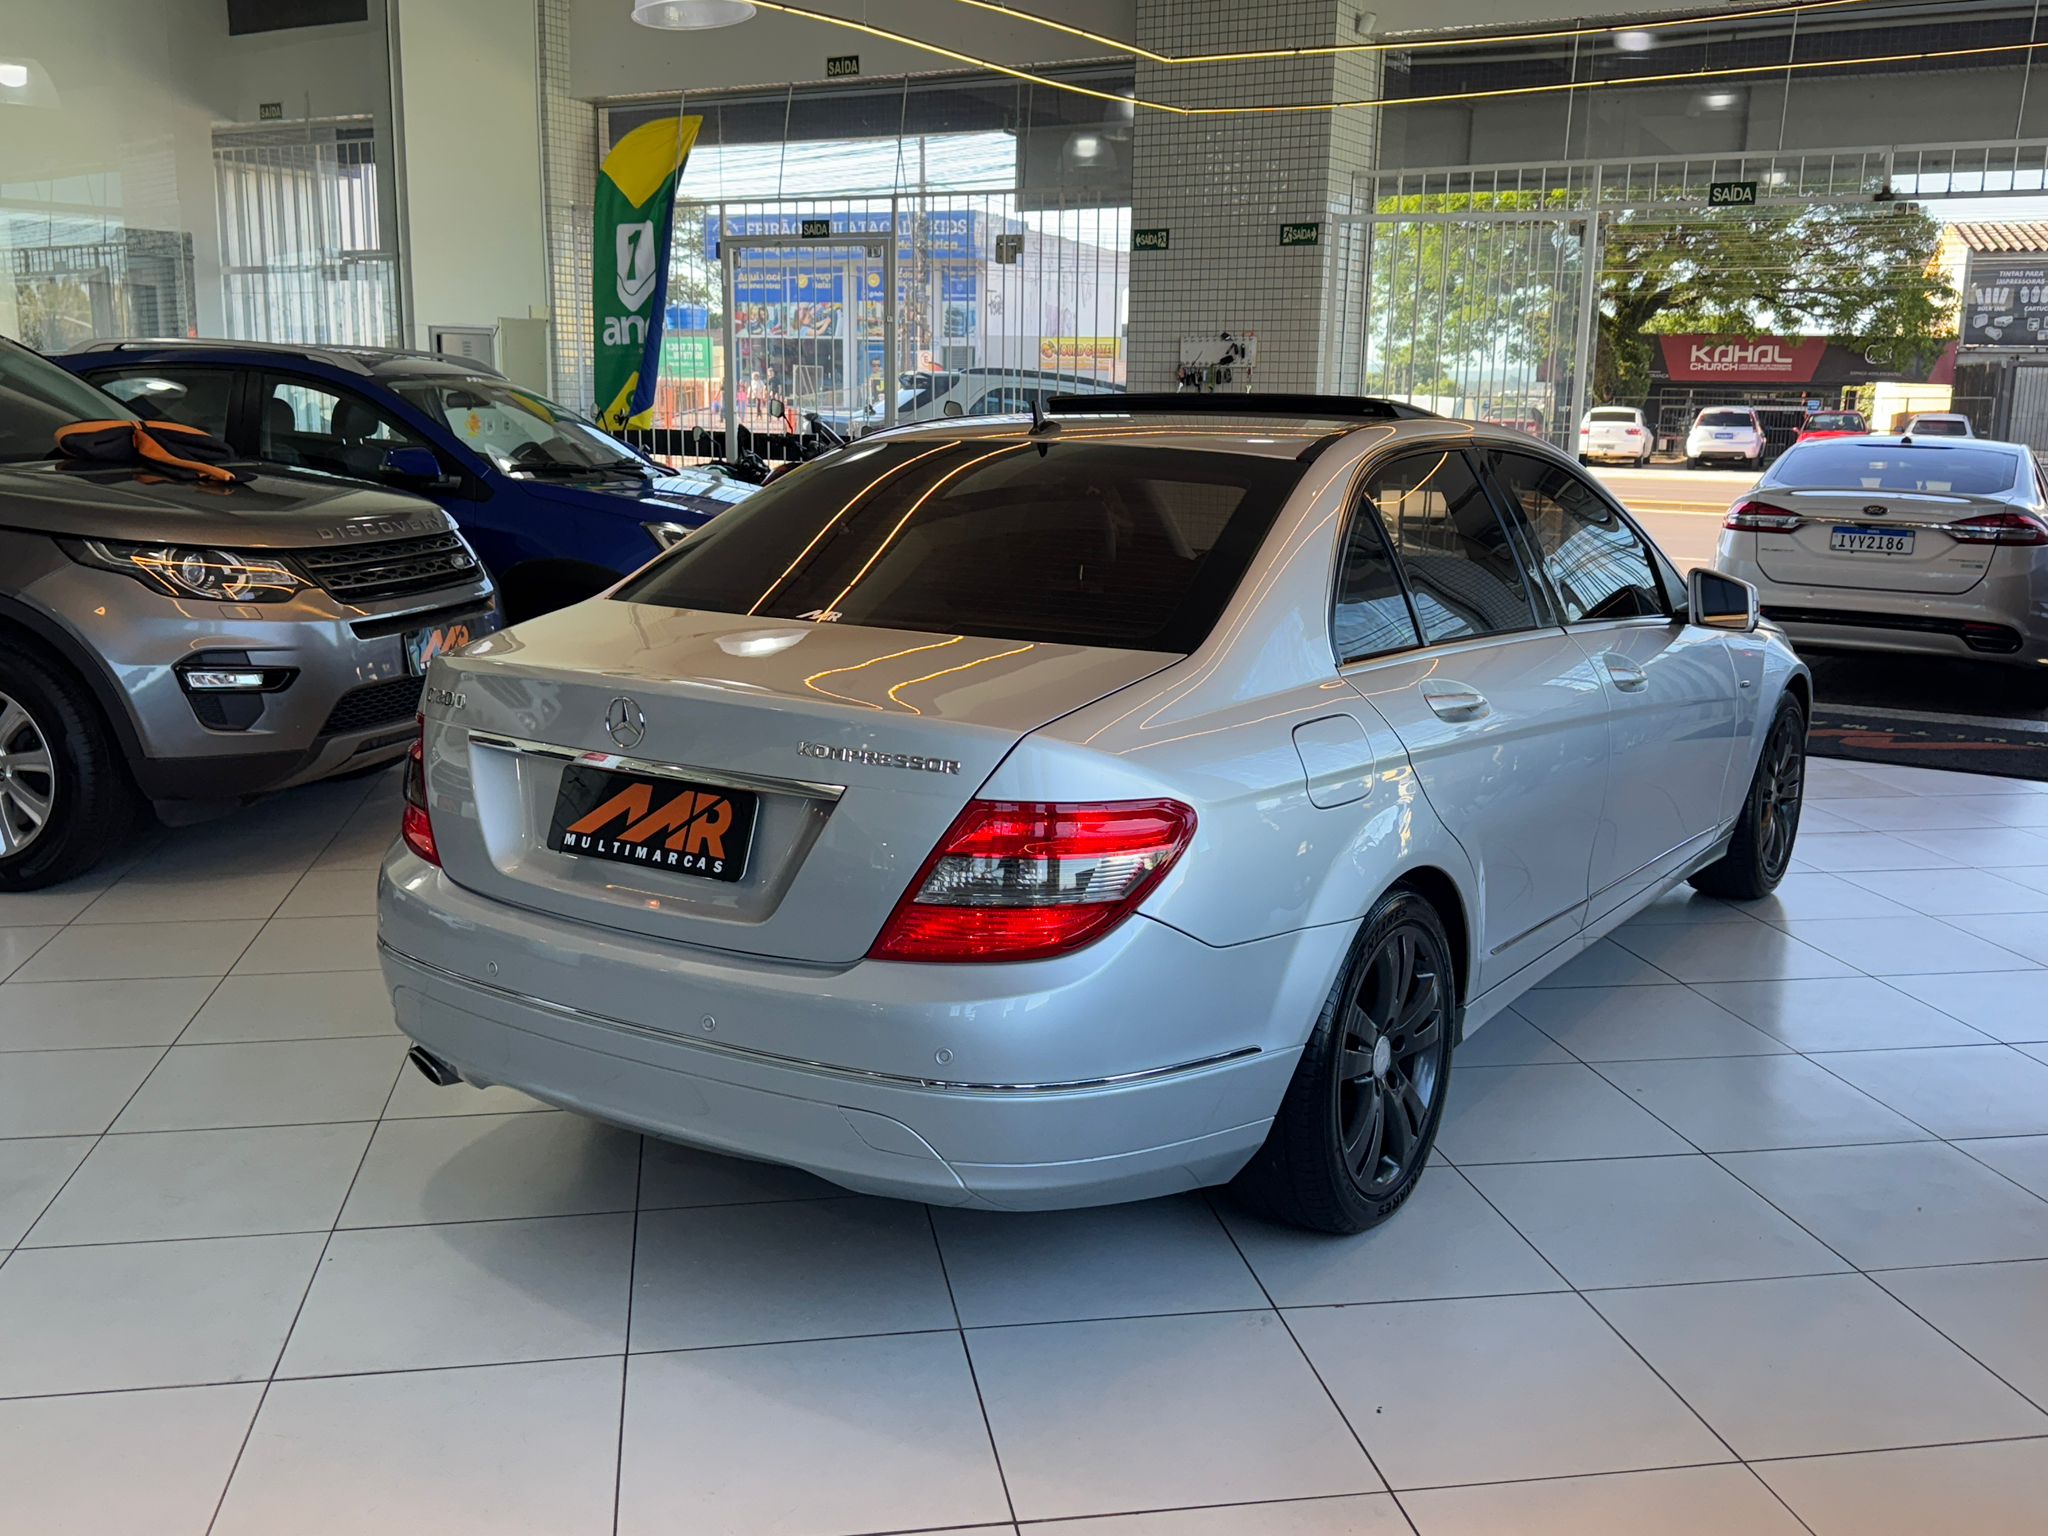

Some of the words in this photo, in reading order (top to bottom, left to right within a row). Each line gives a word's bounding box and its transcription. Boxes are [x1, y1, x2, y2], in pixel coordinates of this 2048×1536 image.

[829, 57, 858, 75] SAÍDA
[1712, 184, 1752, 202] SAÍDA
[803, 220, 828, 237] SAÍDA
[1292, 225, 1311, 240] SAÍDA
[1140, 232, 1157, 246] SAÍDA
[603, 315, 650, 346] an
[1690, 344, 1793, 363] KAHAL
[1689, 362, 1738, 372] CHURCH
[316, 511, 444, 540] DISCOVERY
[797, 740, 962, 775] KOMPRESSOR
[563, 832, 724, 874] MULTIMARCAS
